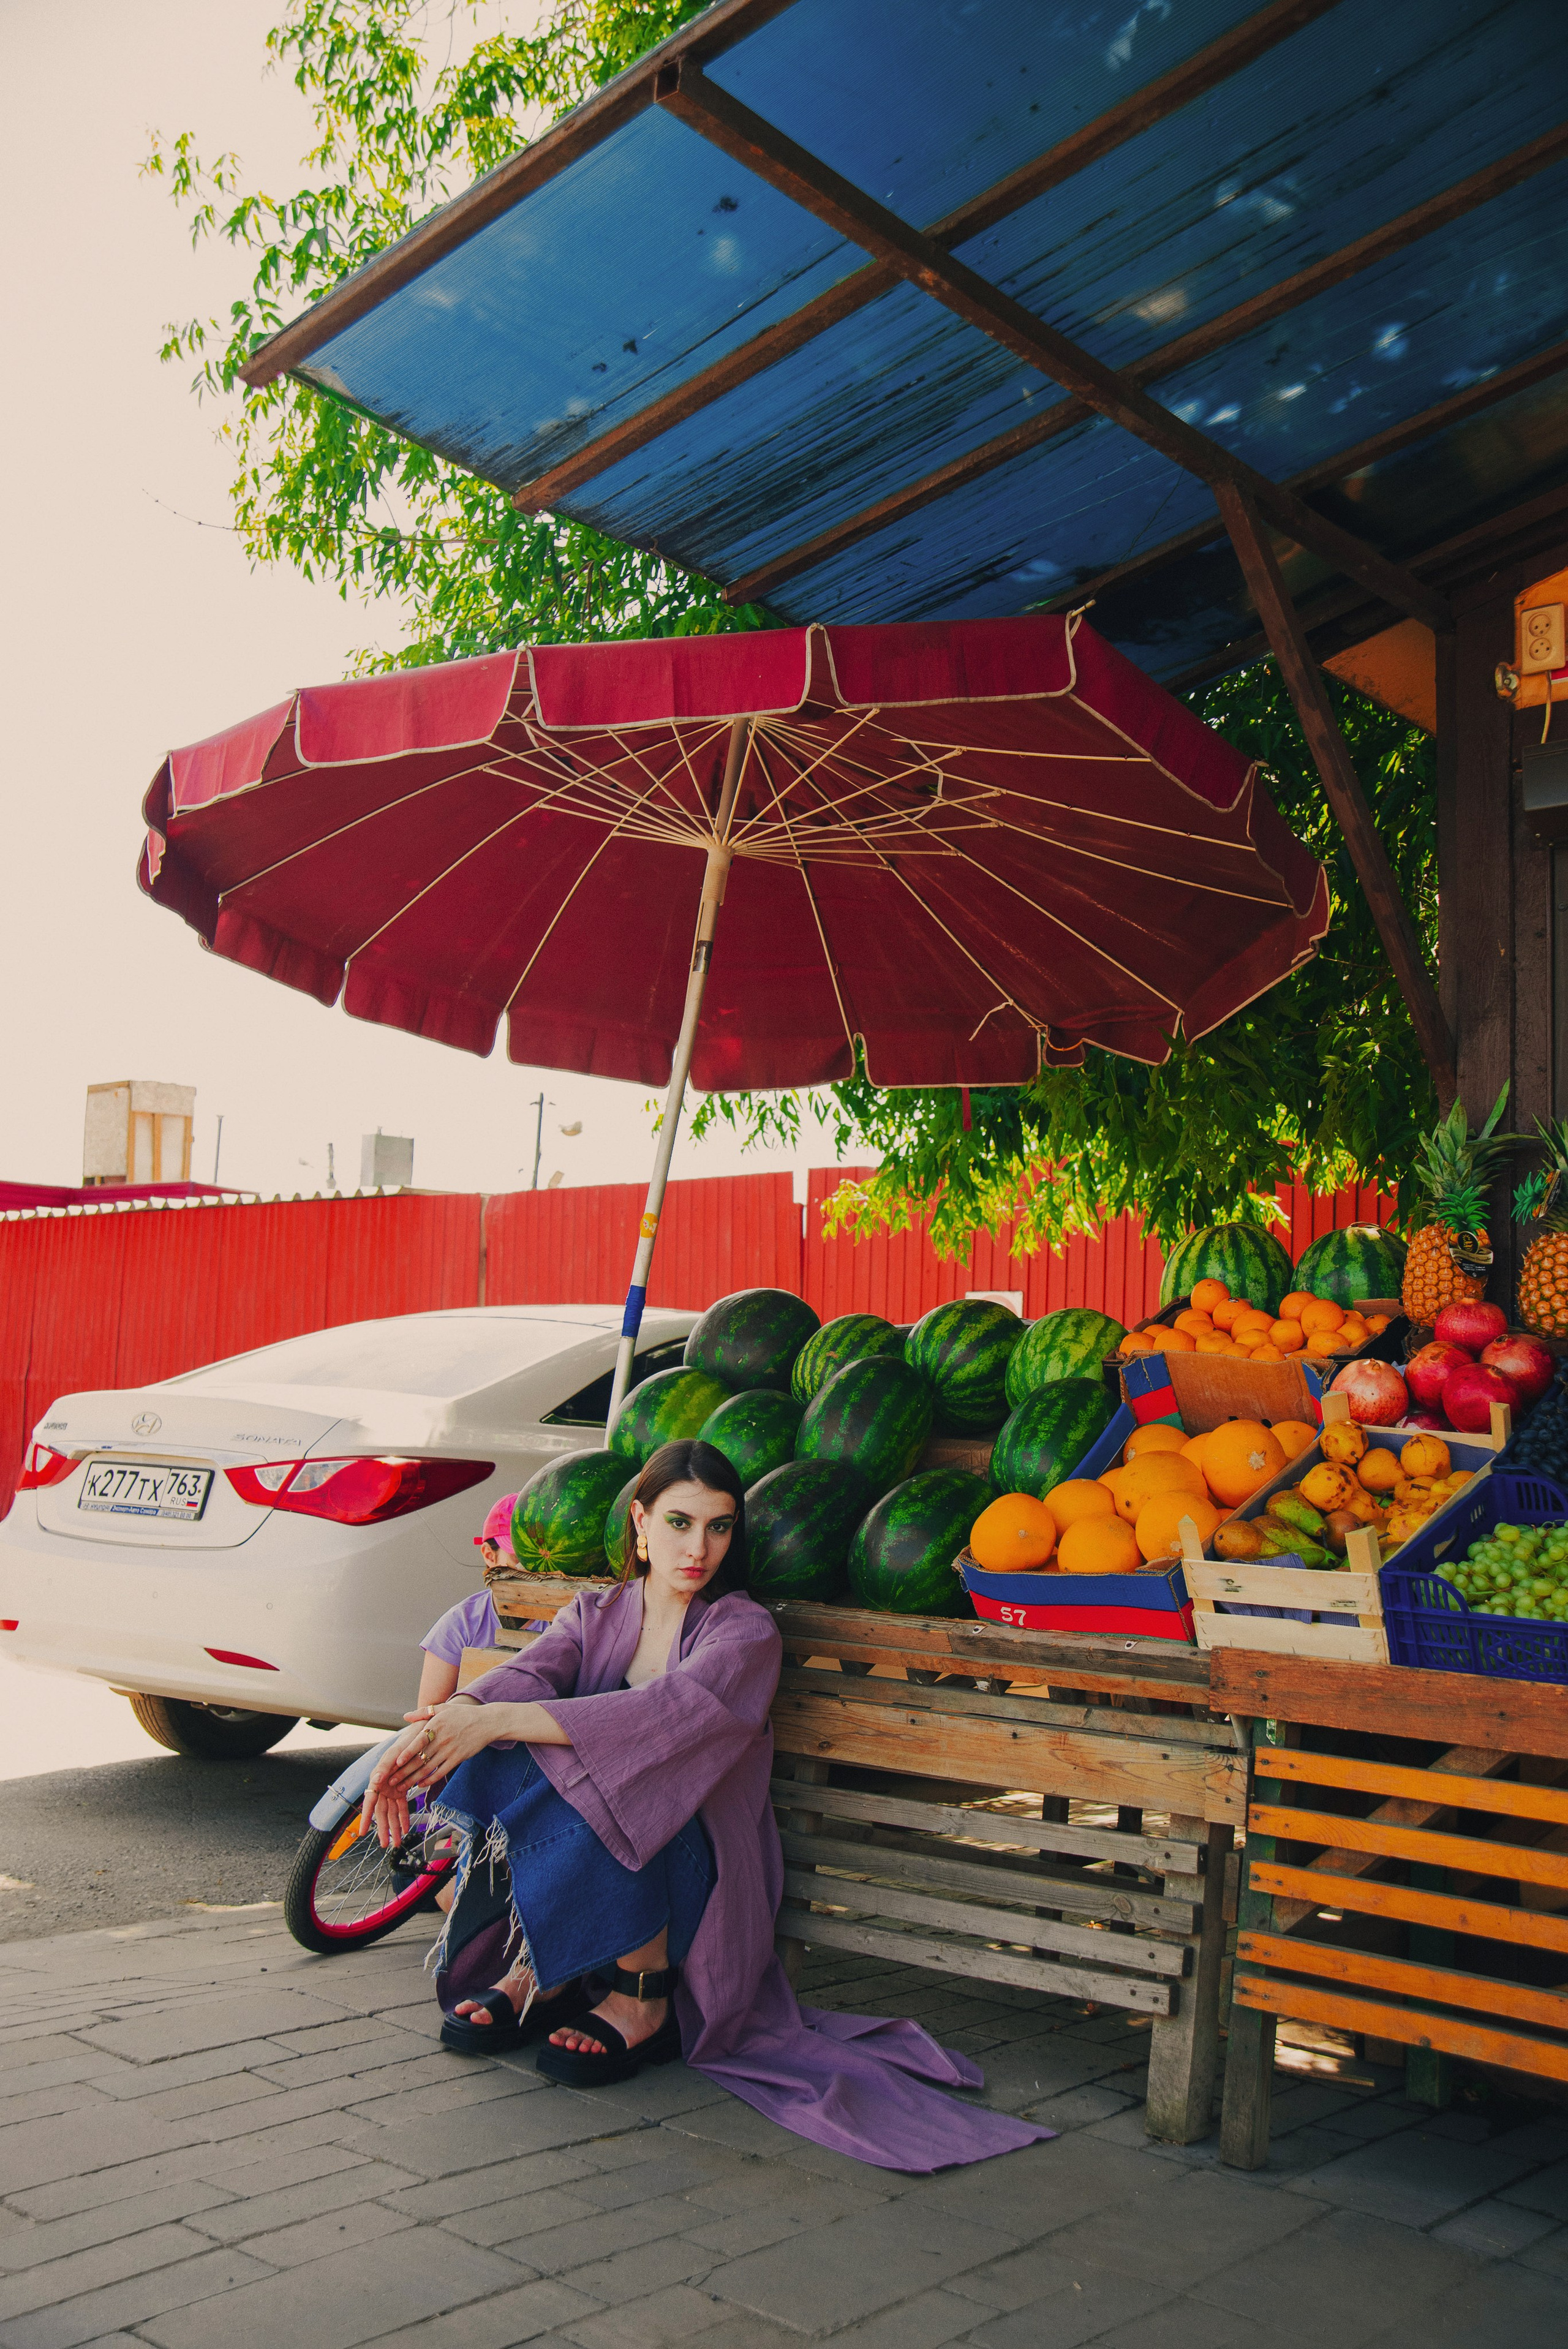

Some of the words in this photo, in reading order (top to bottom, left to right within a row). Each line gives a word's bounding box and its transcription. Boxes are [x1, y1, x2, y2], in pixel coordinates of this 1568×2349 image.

[167, 1473, 201, 1496] 763
[170, 1497, 186, 1506] RUS
[1000, 1607, 1027, 1626] 57
